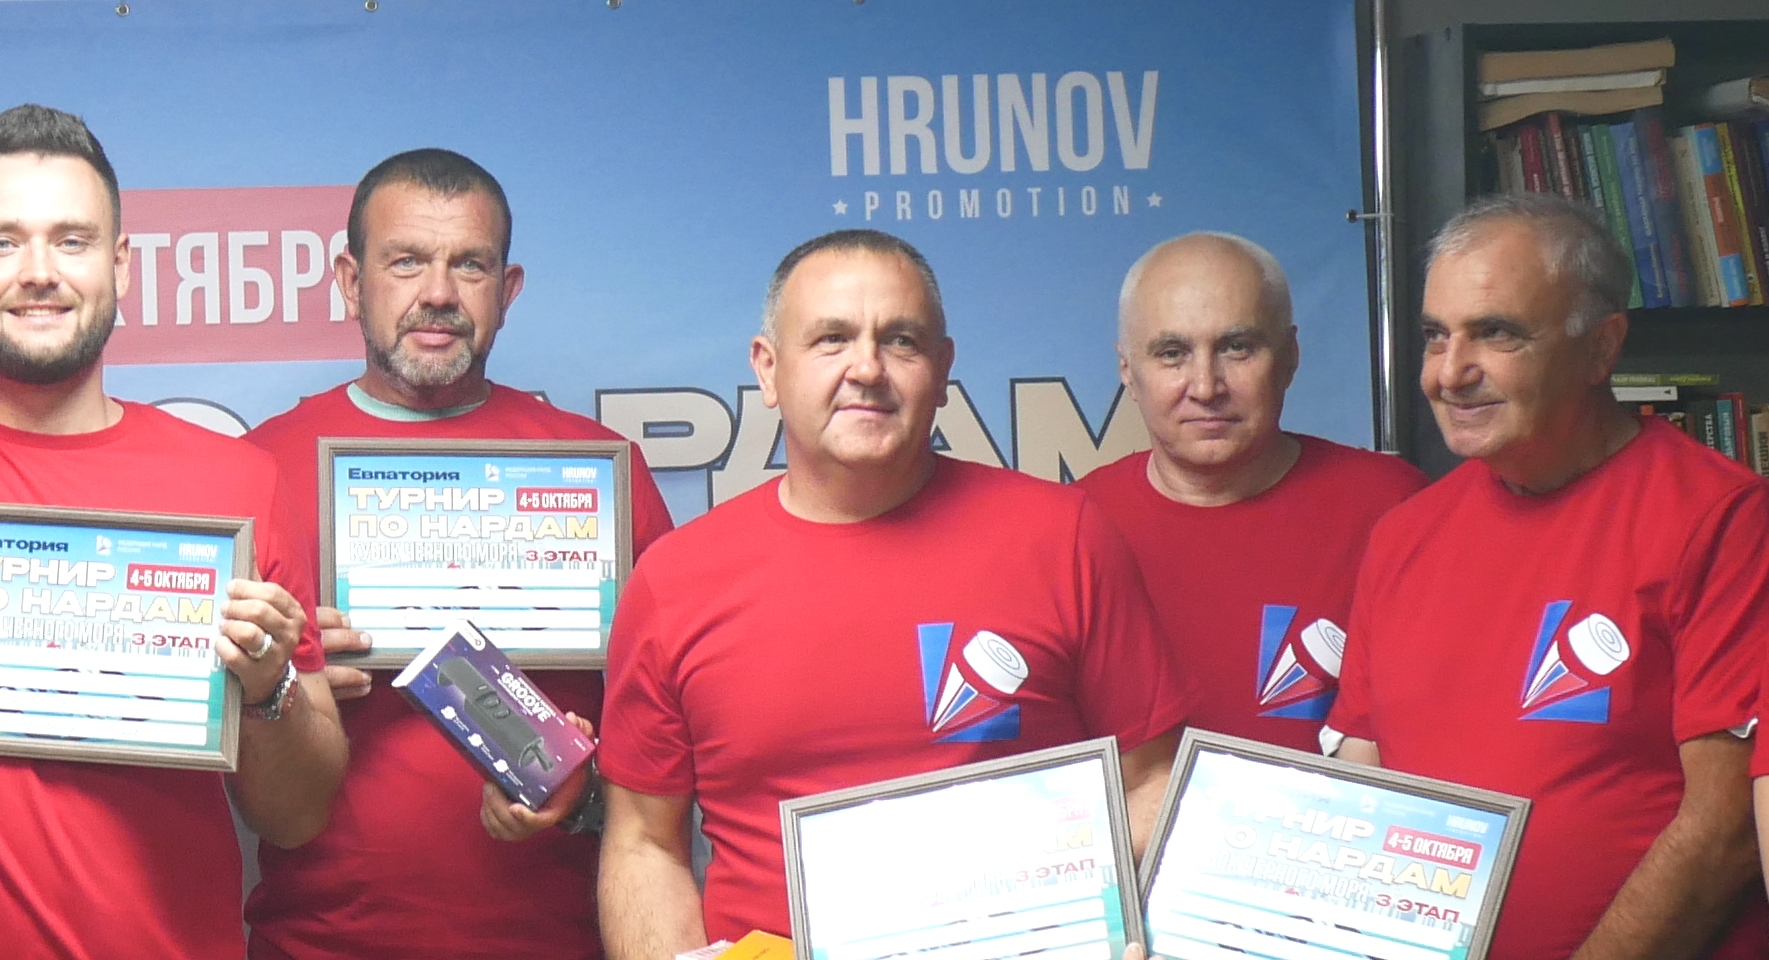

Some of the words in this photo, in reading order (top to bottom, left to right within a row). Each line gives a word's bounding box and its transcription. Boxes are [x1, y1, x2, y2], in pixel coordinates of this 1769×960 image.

[828, 70, 1159, 176] HRUNOV
[864, 185, 1130, 221] PROMOTION
[348, 467, 460, 483] Евпатория
[348, 487, 506, 512] ТУРНИР
[519, 492, 540, 509] 4-5
[541, 492, 592, 509] ОКТЯБРЯ
[349, 514, 409, 538] ПО
[420, 514, 598, 541] НАРДАМ
[525, 550, 539, 562] 3
[544, 550, 598, 562] ЭТАП
[130, 569, 153, 588] 4-5
[154, 570, 210, 591] ОКТЯБРЯ
[21, 587, 215, 625] НАРДАМ
[131, 633, 146, 646] 3
[151, 634, 211, 650] ЭТАП
[499, 671, 552, 722] GROOVE
[1388, 832, 1414, 851] 4-5
[1413, 837, 1474, 865] ОКТЯБРЯ
[1035, 858, 1096, 879] ЭТАП
[1268, 831, 1473, 898] НАРДАМ
[1375, 893, 1392, 908] 3
[1396, 897, 1461, 924] ЭТАП
